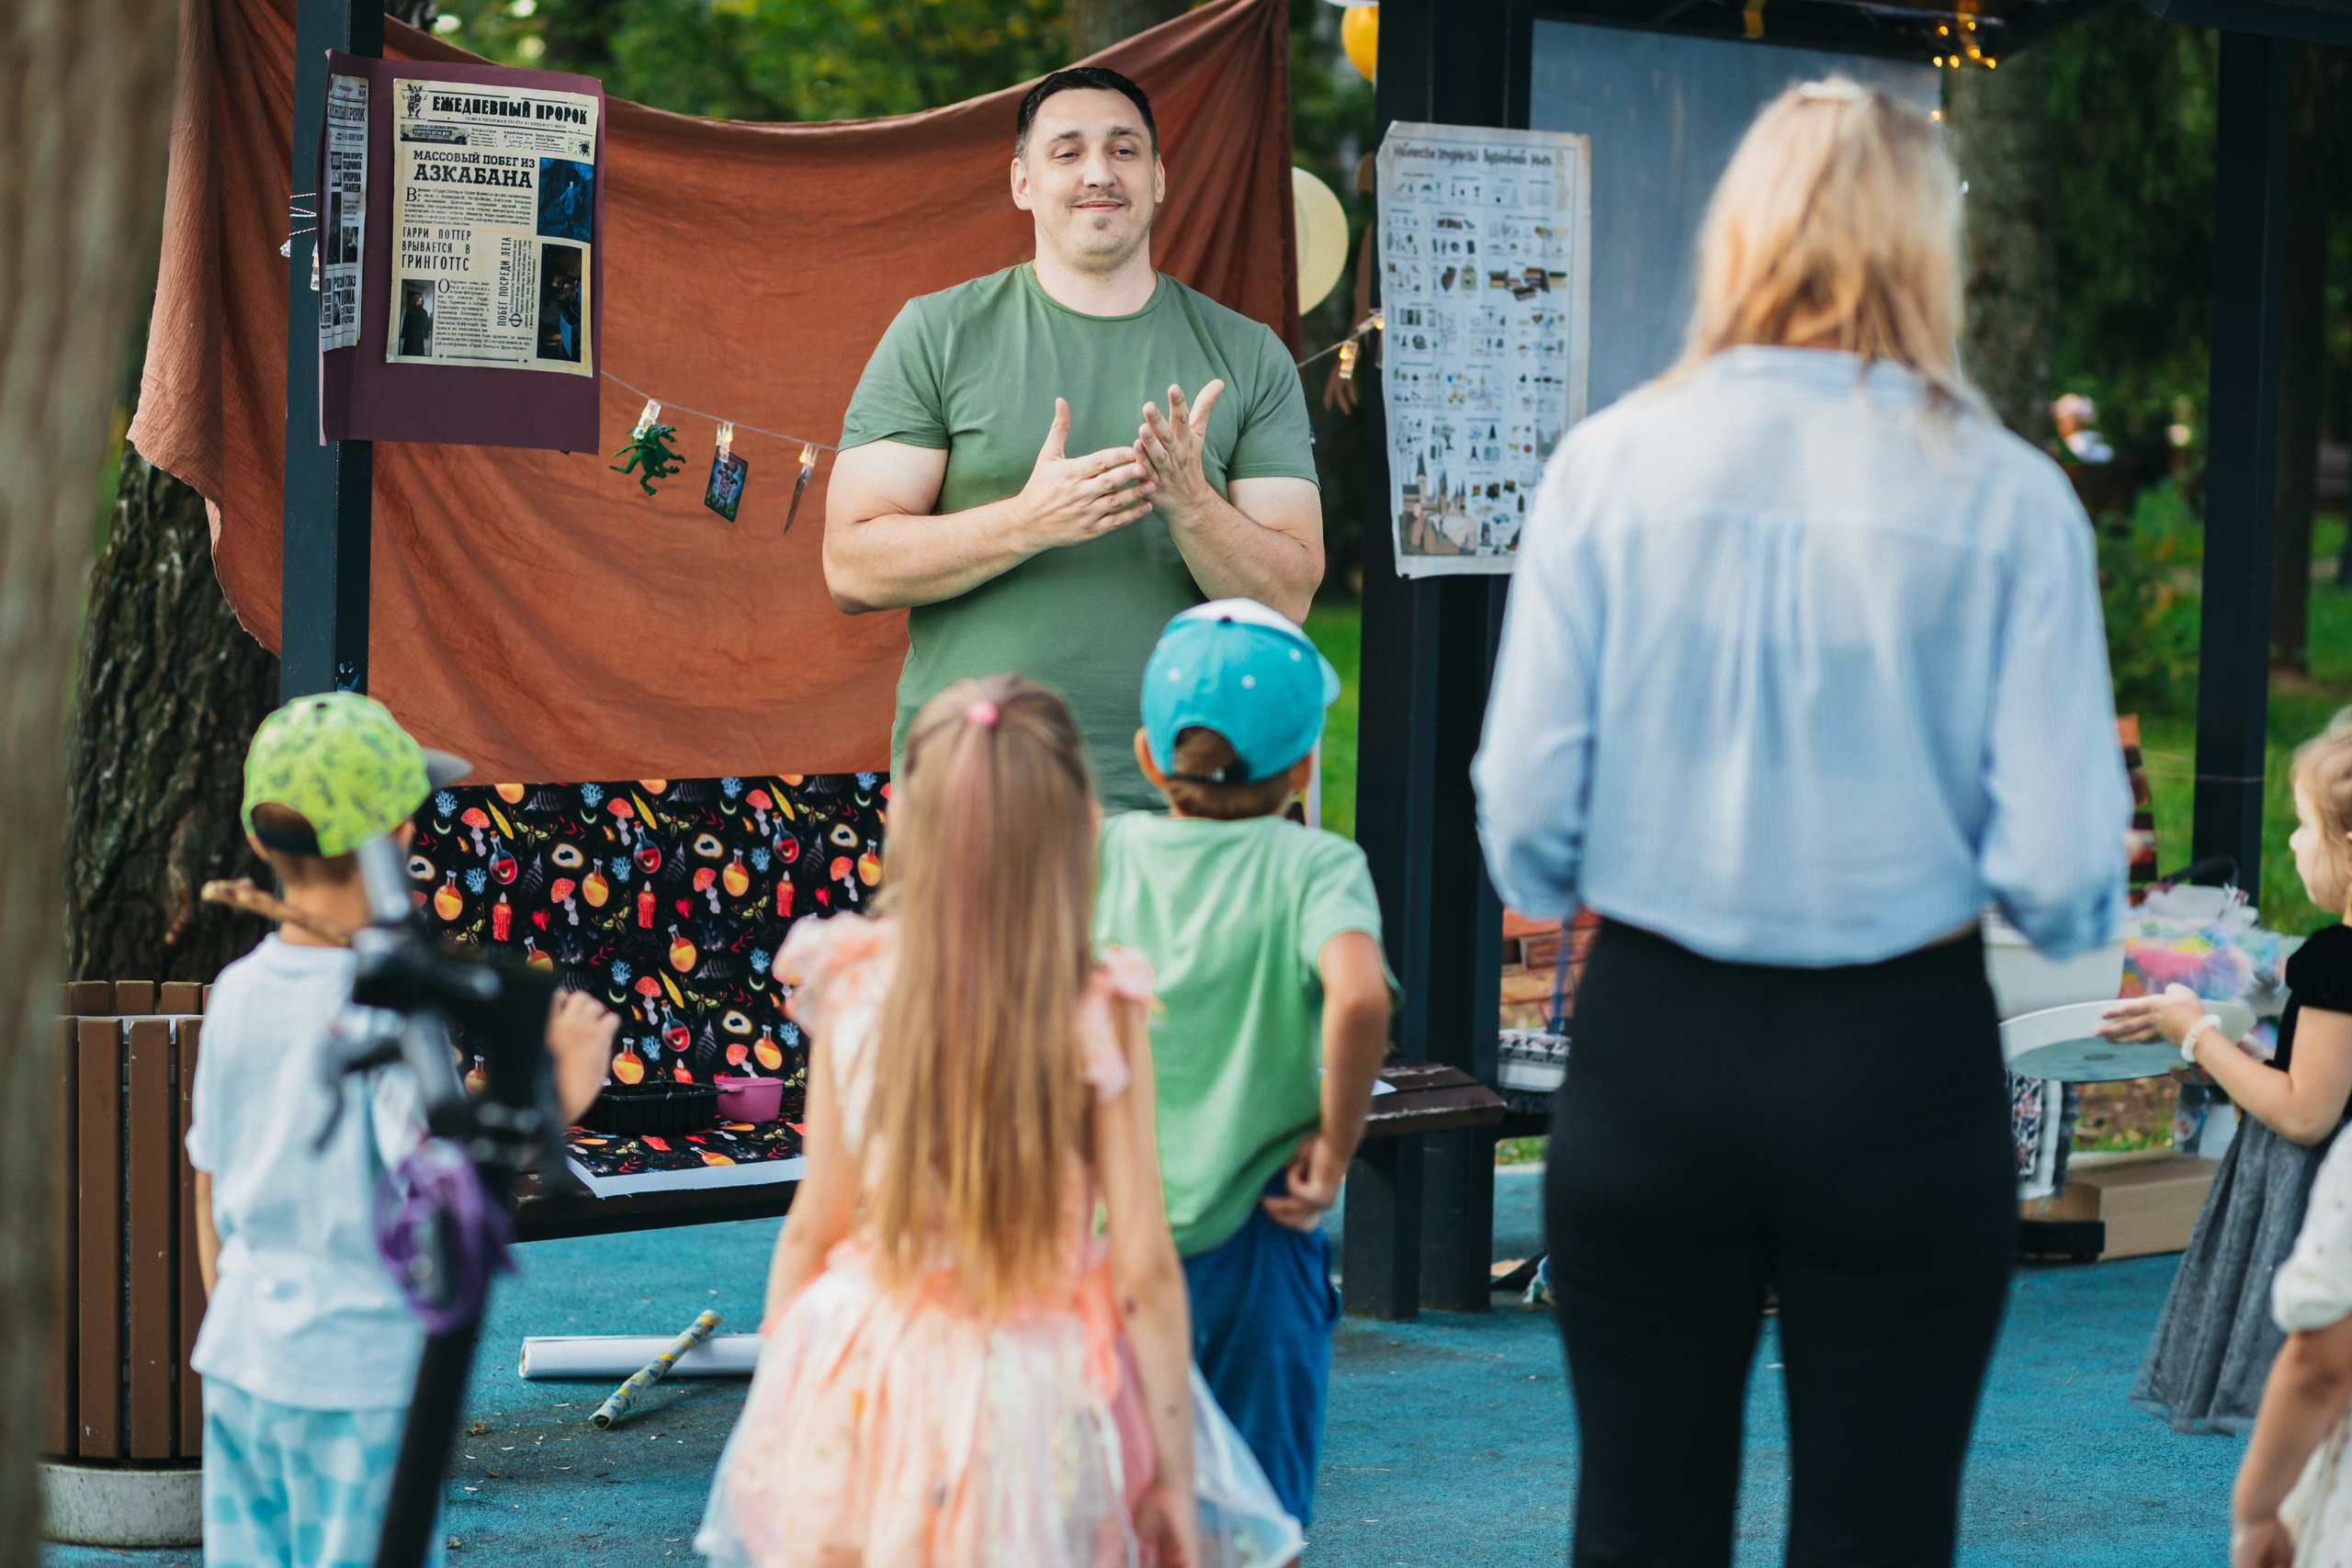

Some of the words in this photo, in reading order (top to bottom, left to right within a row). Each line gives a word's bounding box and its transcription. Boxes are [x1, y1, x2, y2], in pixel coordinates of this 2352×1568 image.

[432, 96, 531, 118] ЕЖЕДНЕВНЫЙ
[536, 105, 587, 125] ПРОРОК
[413, 150, 481, 164] МАССОВЫЙ
[483, 154, 518, 167] ПОБЕГ
[520, 158, 536, 168] ИЗ
[413, 164, 533, 188] АЗКАБАНА
[402, 227, 429, 239] ГАРРИ
[438, 228, 471, 241] ПОТТЕР
[401, 241, 452, 254] ВРЫВАЕТСЯ
[465, 243, 470, 254] В
[501, 237, 511, 257] ЛЕТА
[401, 254, 469, 272] ГРИНГОТТС
[498, 260, 511, 298] ПОСРЕДИ
[497, 301, 507, 327] ПОБЕГ
